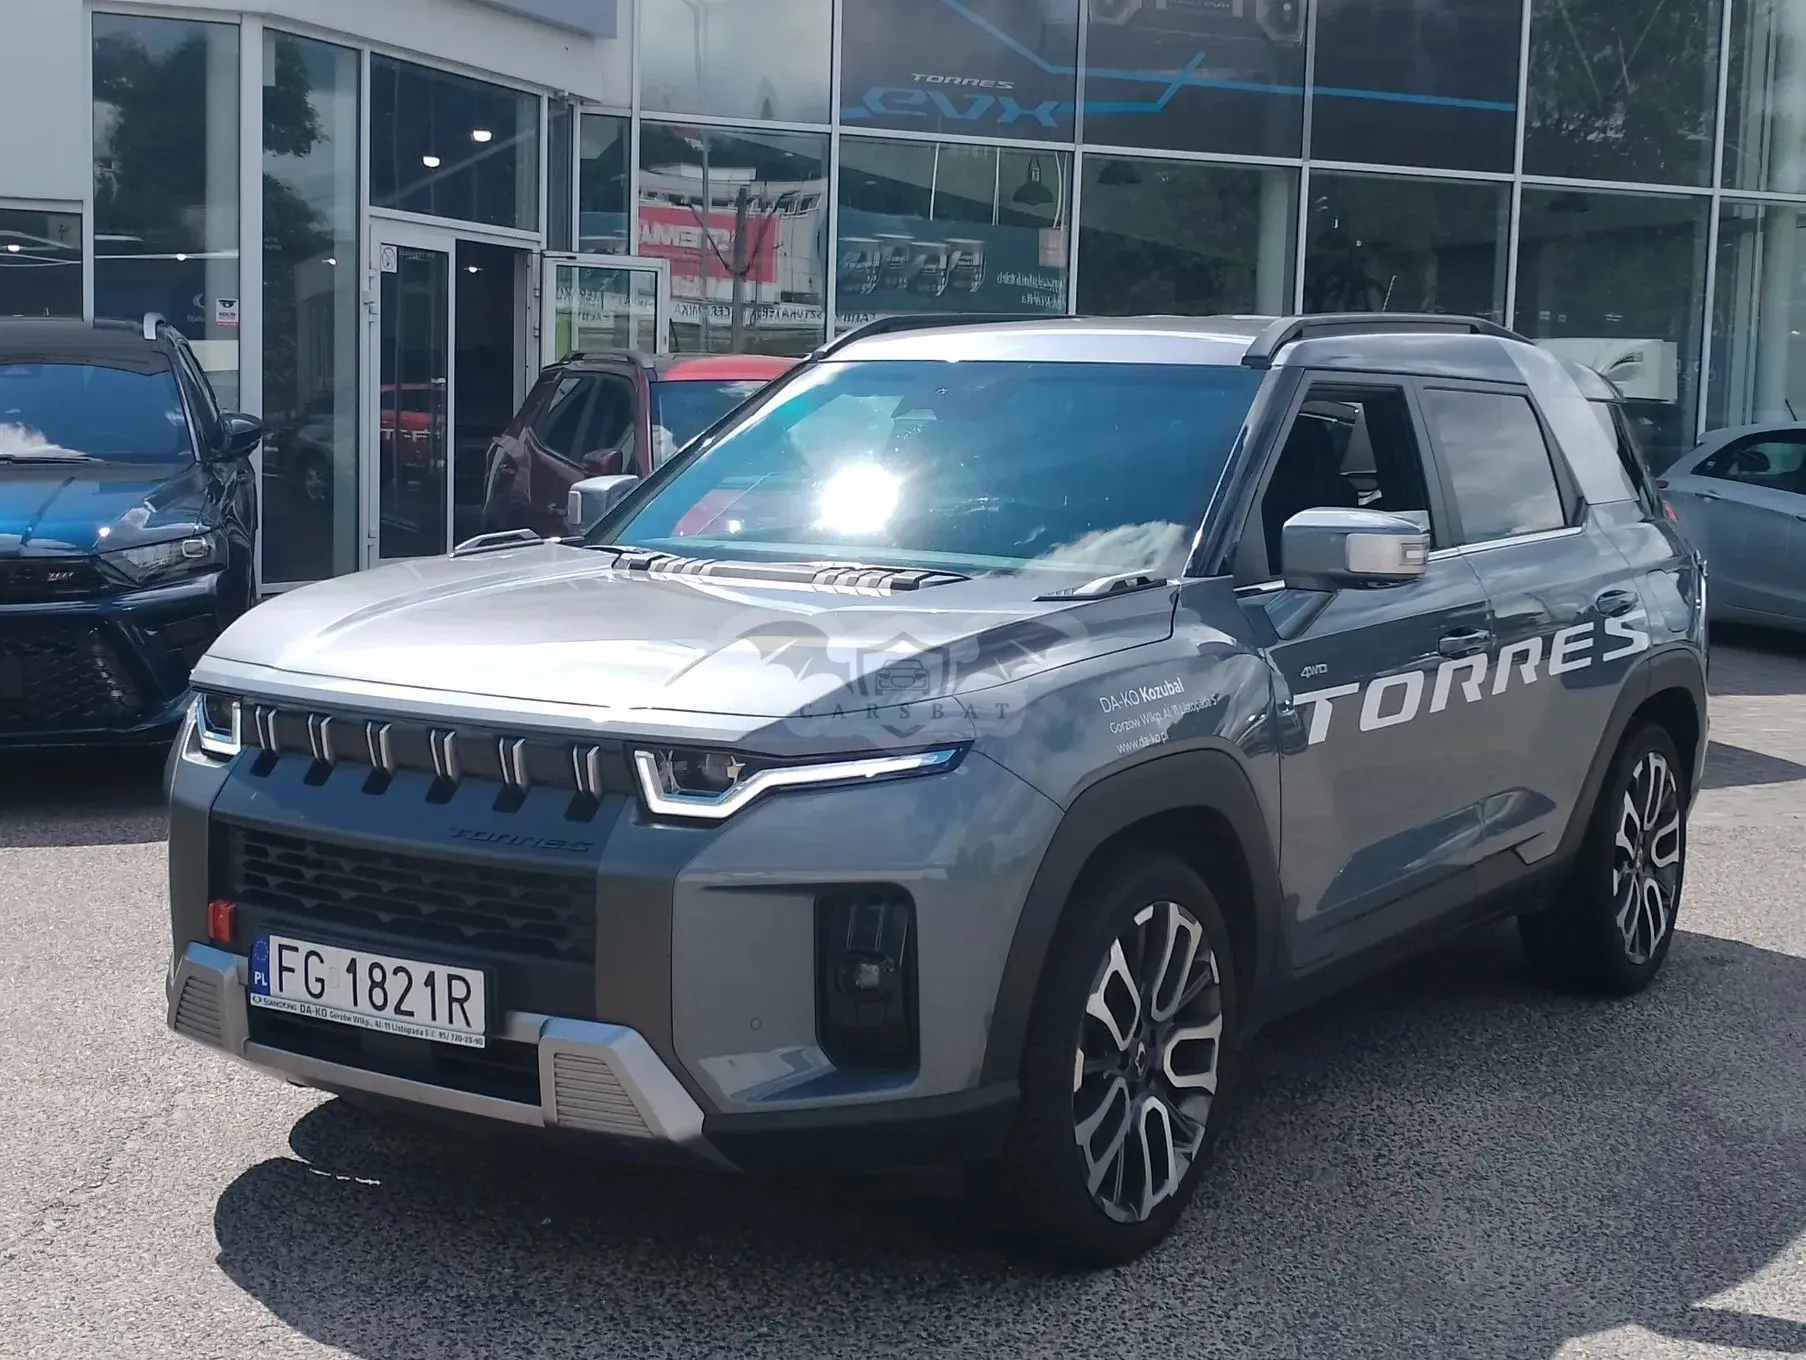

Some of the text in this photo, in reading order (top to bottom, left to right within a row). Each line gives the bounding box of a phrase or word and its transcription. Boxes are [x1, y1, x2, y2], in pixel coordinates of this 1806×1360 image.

[911, 73, 1015, 89] TORRES
[1293, 609, 1651, 745] TORRES
[1301, 663, 1328, 678] 4WD
[1099, 677, 1185, 713] DA-KO Kozubal
[1116, 728, 1169, 754] www.da-ko.pl
[450, 827, 594, 851] TORRES
[254, 971, 268, 986] PL
[277, 943, 473, 1028] FG 1821R
[300, 1004, 327, 1018] DA-KO
[391, 1023, 423, 1037] Listopada
